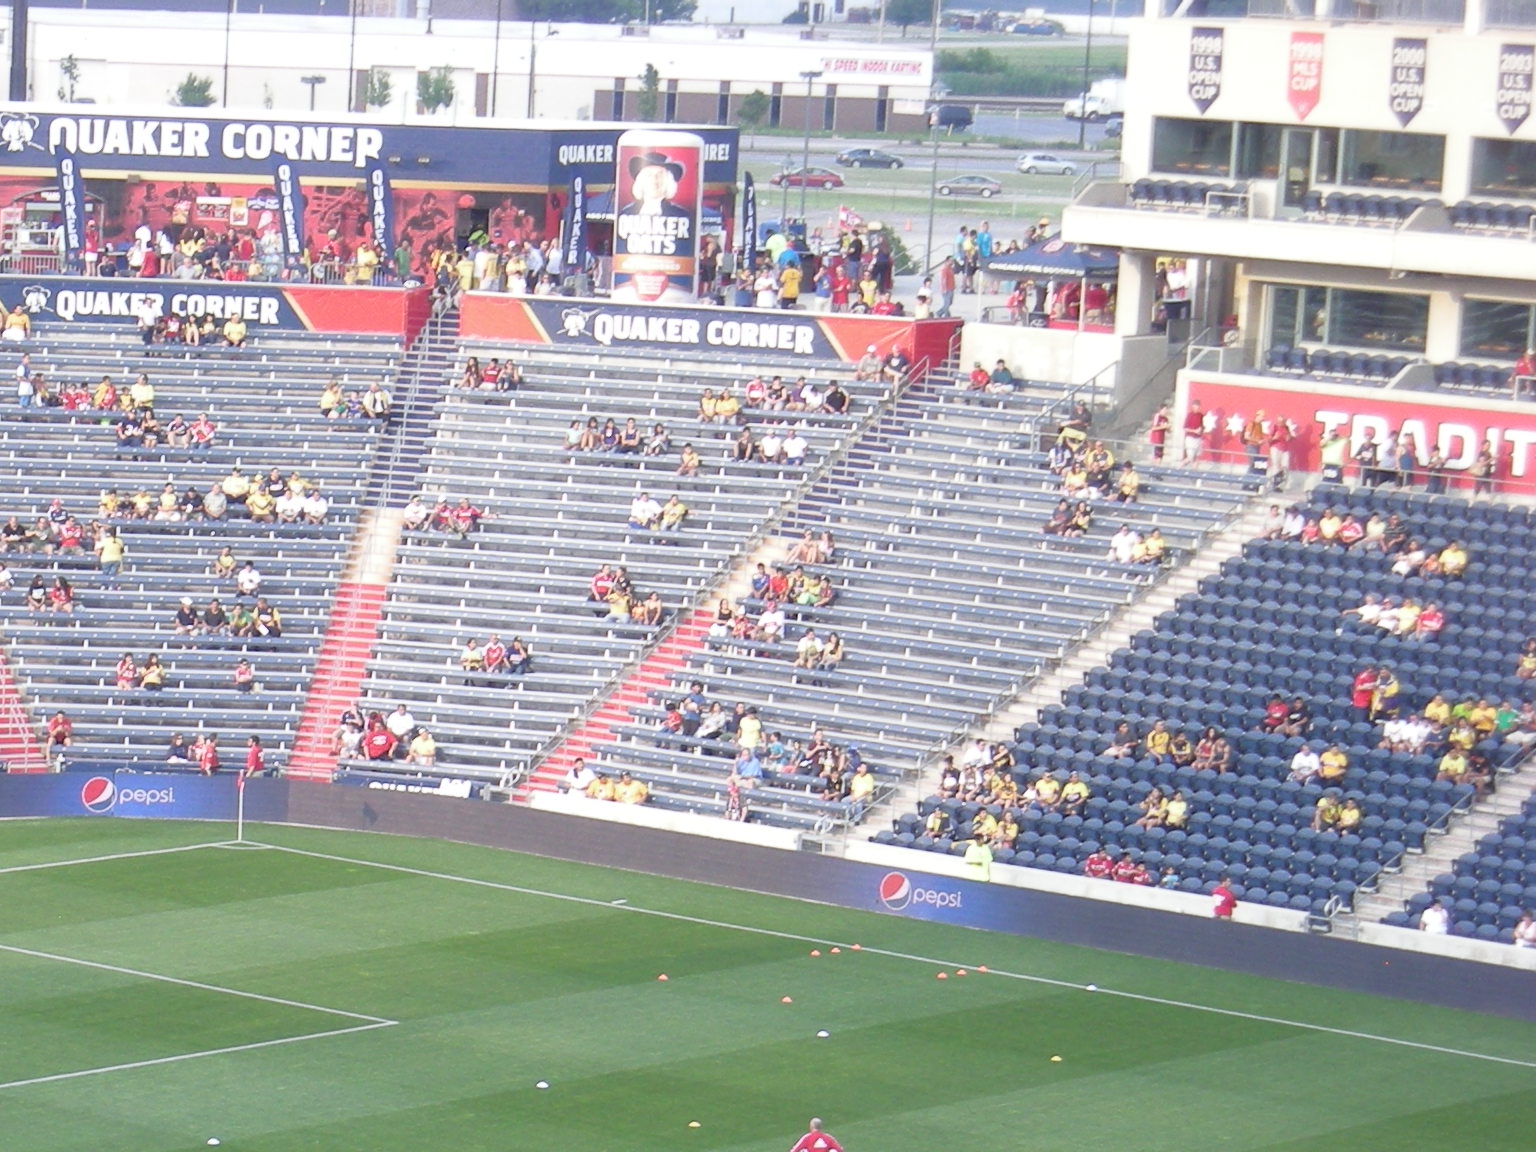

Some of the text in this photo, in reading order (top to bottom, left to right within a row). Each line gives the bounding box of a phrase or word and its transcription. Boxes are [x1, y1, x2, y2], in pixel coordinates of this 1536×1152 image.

[1194, 57, 1217, 70] U.S.
[1292, 61, 1318, 76] MLS
[1189, 71, 1221, 85] OPEN
[1291, 76, 1318, 91] CUP
[1396, 68, 1419, 82] U.S.
[1503, 74, 1526, 89] U.S.
[1191, 85, 1218, 100] CUP
[1391, 83, 1423, 97] OPEN
[1498, 89, 1531, 104] OPEN
[1393, 97, 1420, 112] CUP
[1500, 104, 1528, 120] CUP
[49, 117, 384, 168] QUAKER CORNER
[559, 143, 730, 166] QUAKER IRE!
[61, 158, 80, 249] QUAKER
[278, 164, 300, 254] QUAKER
[567, 176, 582, 265] QUAKER
[618, 214, 690, 239] QUAKER
[627, 234, 676, 255] OATS
[56, 290, 280, 325] QUAKER CORNER
[594, 313, 814, 355] QUAKER CORNER
[119, 787, 174, 806] pepsi
[913, 887, 962, 909] pepsi
